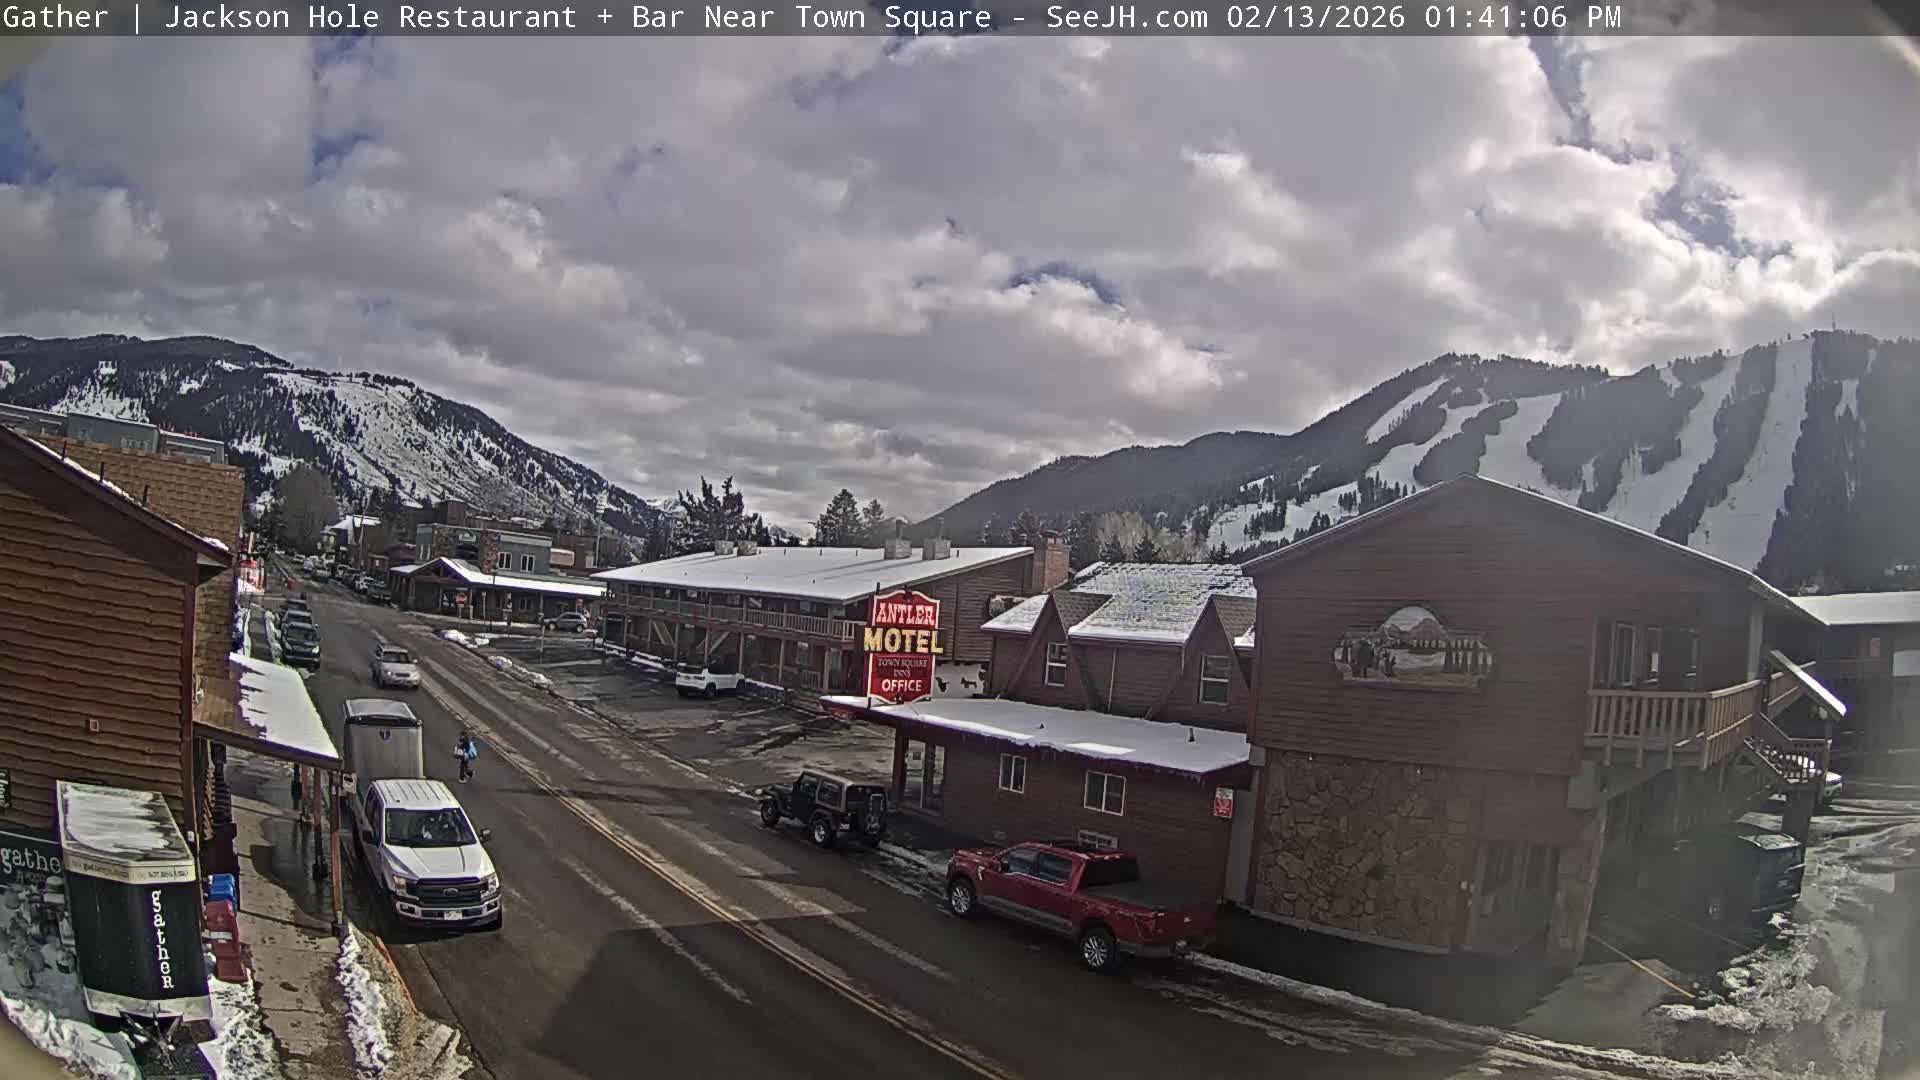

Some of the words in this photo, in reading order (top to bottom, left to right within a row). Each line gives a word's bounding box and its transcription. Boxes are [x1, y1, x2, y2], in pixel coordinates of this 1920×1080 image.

[876, 603, 934, 625] ANTLER
[864, 627, 943, 653] MOTEL
[881, 679, 922, 692] OFFICE
[1, 848, 62, 874] gathe
